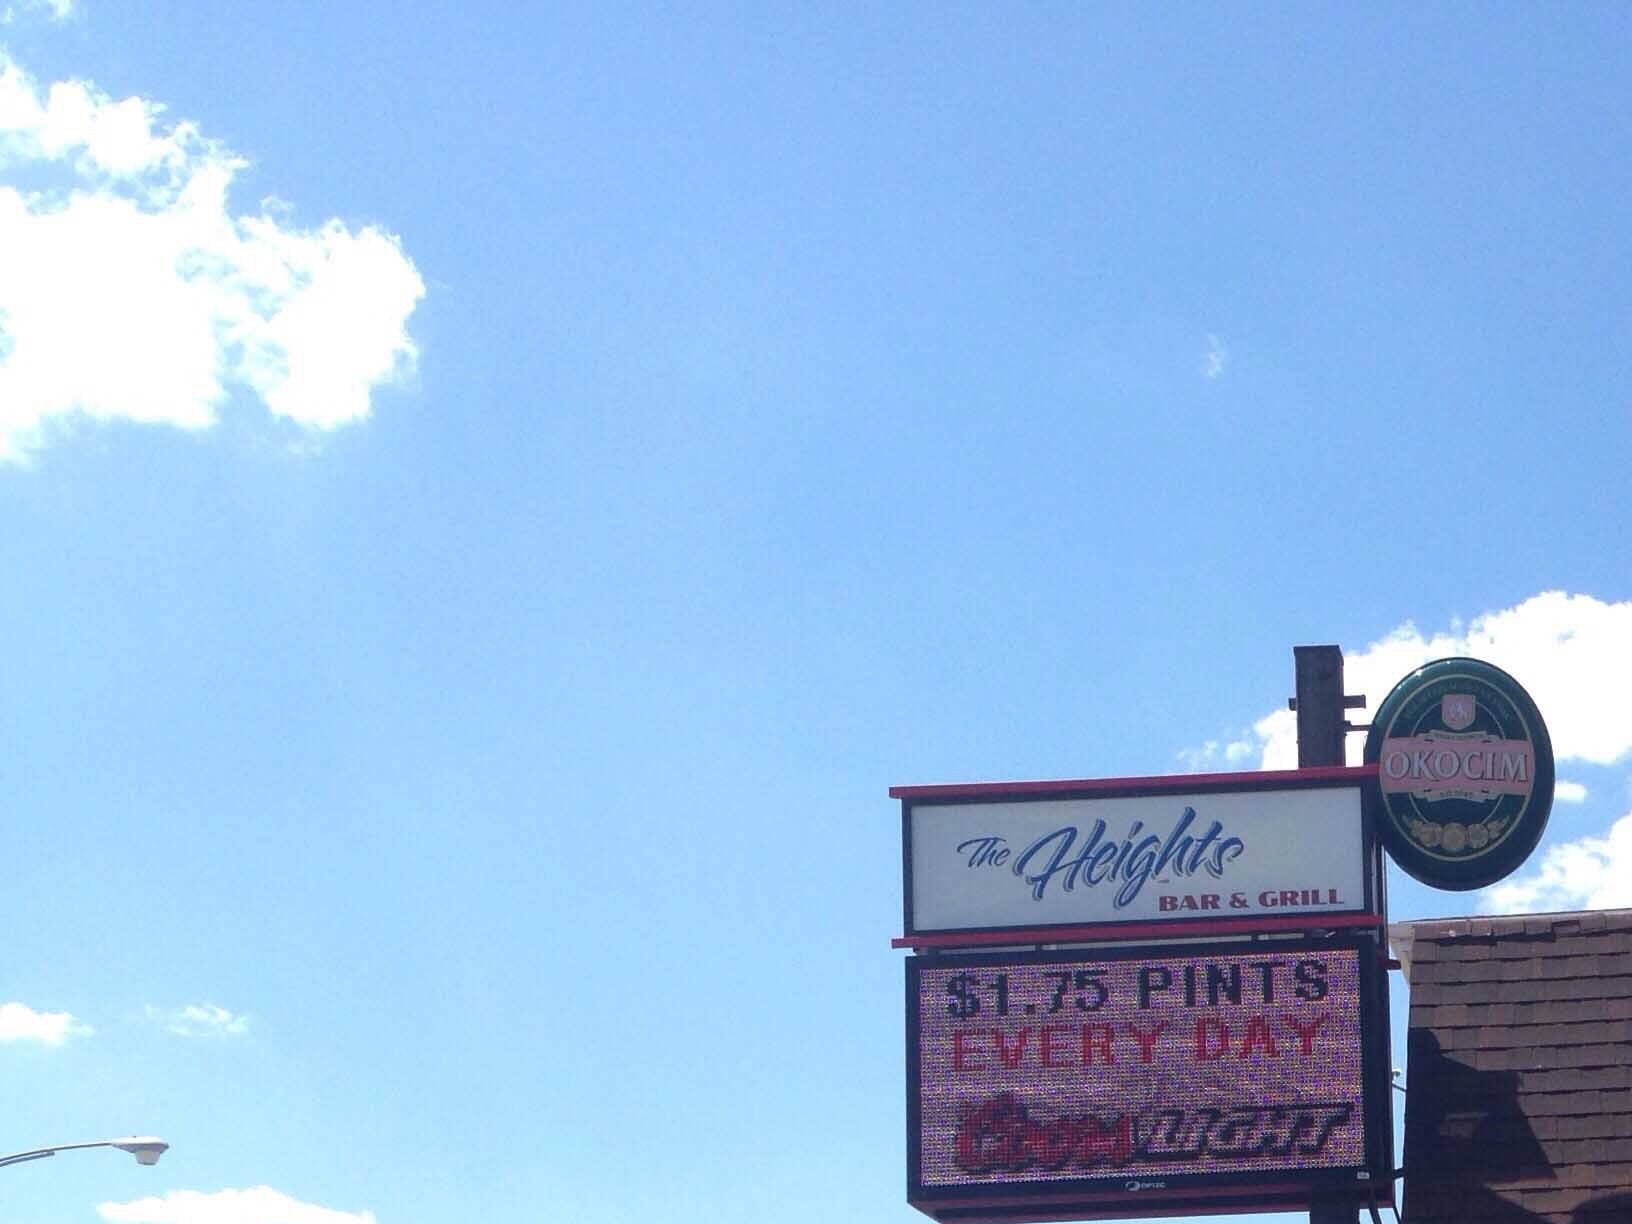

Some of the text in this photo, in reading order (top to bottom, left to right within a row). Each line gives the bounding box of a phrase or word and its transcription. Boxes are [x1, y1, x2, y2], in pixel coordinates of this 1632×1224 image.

[1385, 751, 1529, 782] OKOCIM
[956, 806, 1244, 910] The Heights
[1158, 888, 1344, 912] BAR & GRILL
[947, 959, 1328, 1020] $1.75 PINTS
[951, 1013, 1329, 1072] EVERY DAY
